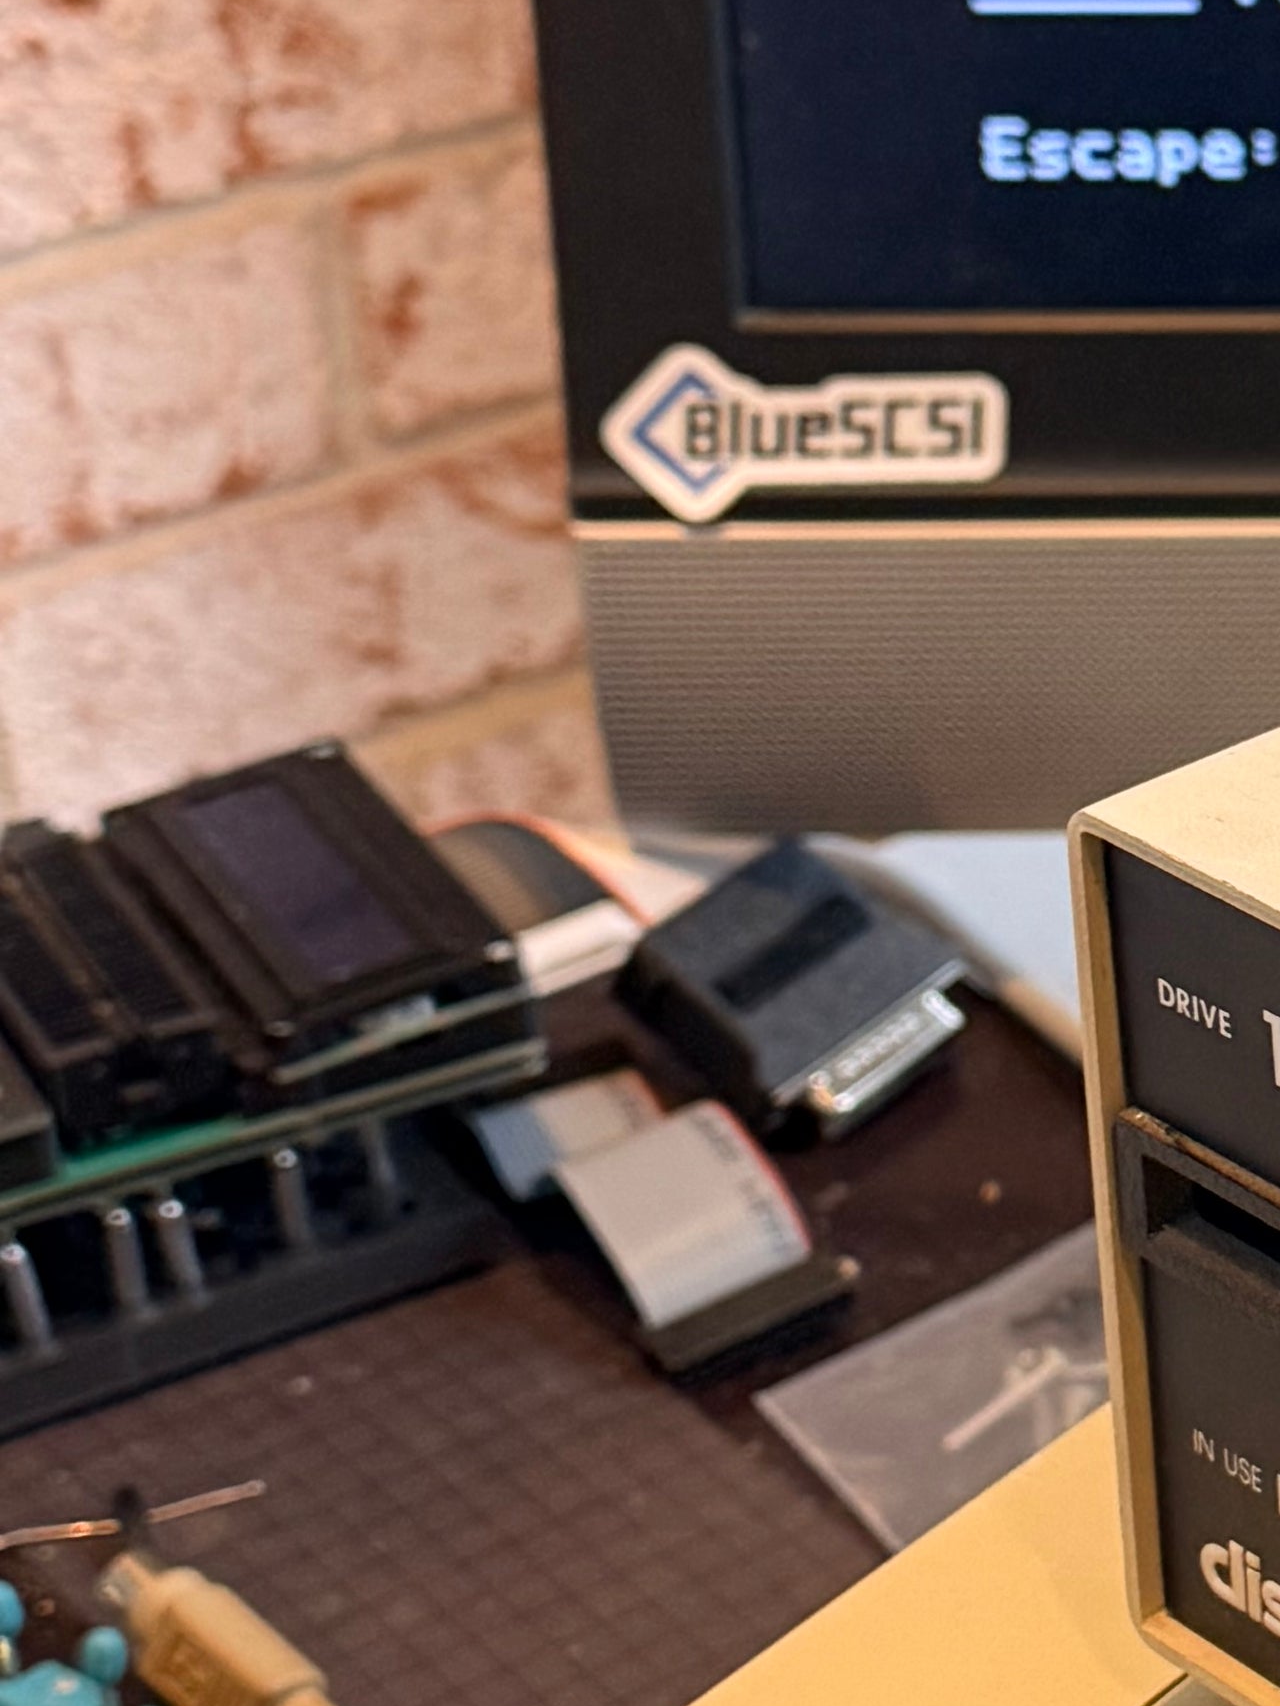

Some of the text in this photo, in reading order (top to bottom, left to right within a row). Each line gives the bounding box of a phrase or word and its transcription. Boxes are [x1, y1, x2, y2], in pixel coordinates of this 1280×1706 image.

[978, 114, 1278, 189] Escape:
[685, 398, 985, 459] BlueSCSI
[1158, 977, 1233, 1039] DRIVE
[1192, 1428, 1263, 1493] IN USE
